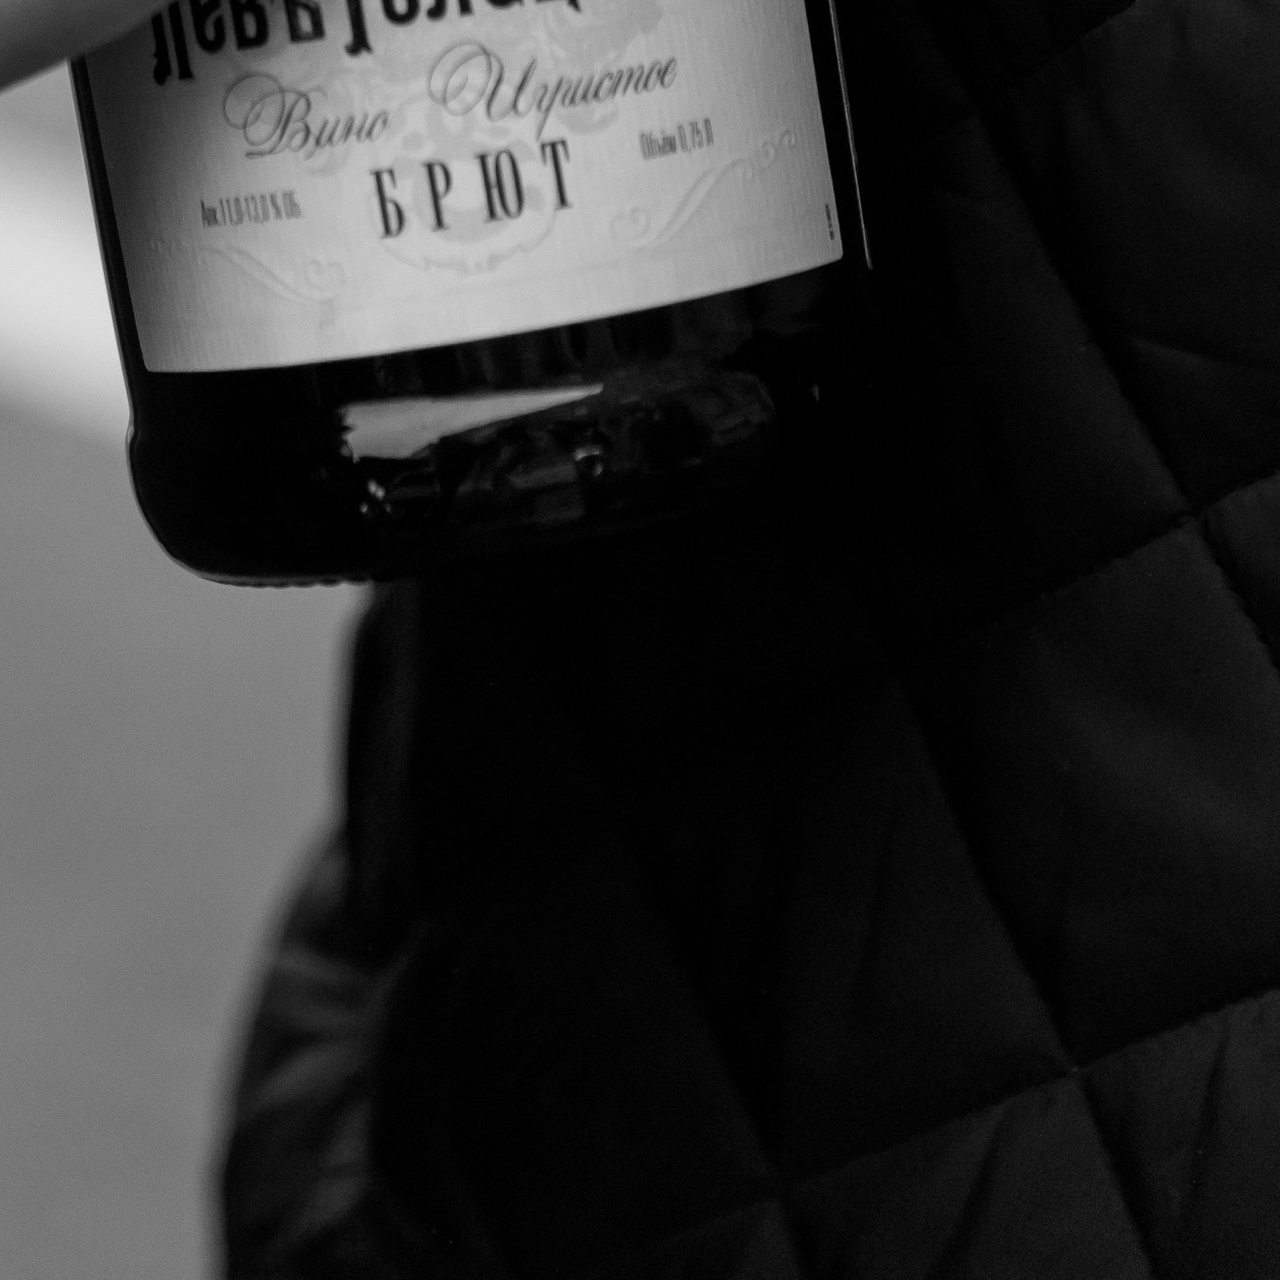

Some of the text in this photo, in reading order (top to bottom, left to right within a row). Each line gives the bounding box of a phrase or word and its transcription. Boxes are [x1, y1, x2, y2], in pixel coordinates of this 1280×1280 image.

[222, 40, 678, 163] Вино Игристое
[370, 138, 573, 239] БРЮТ
